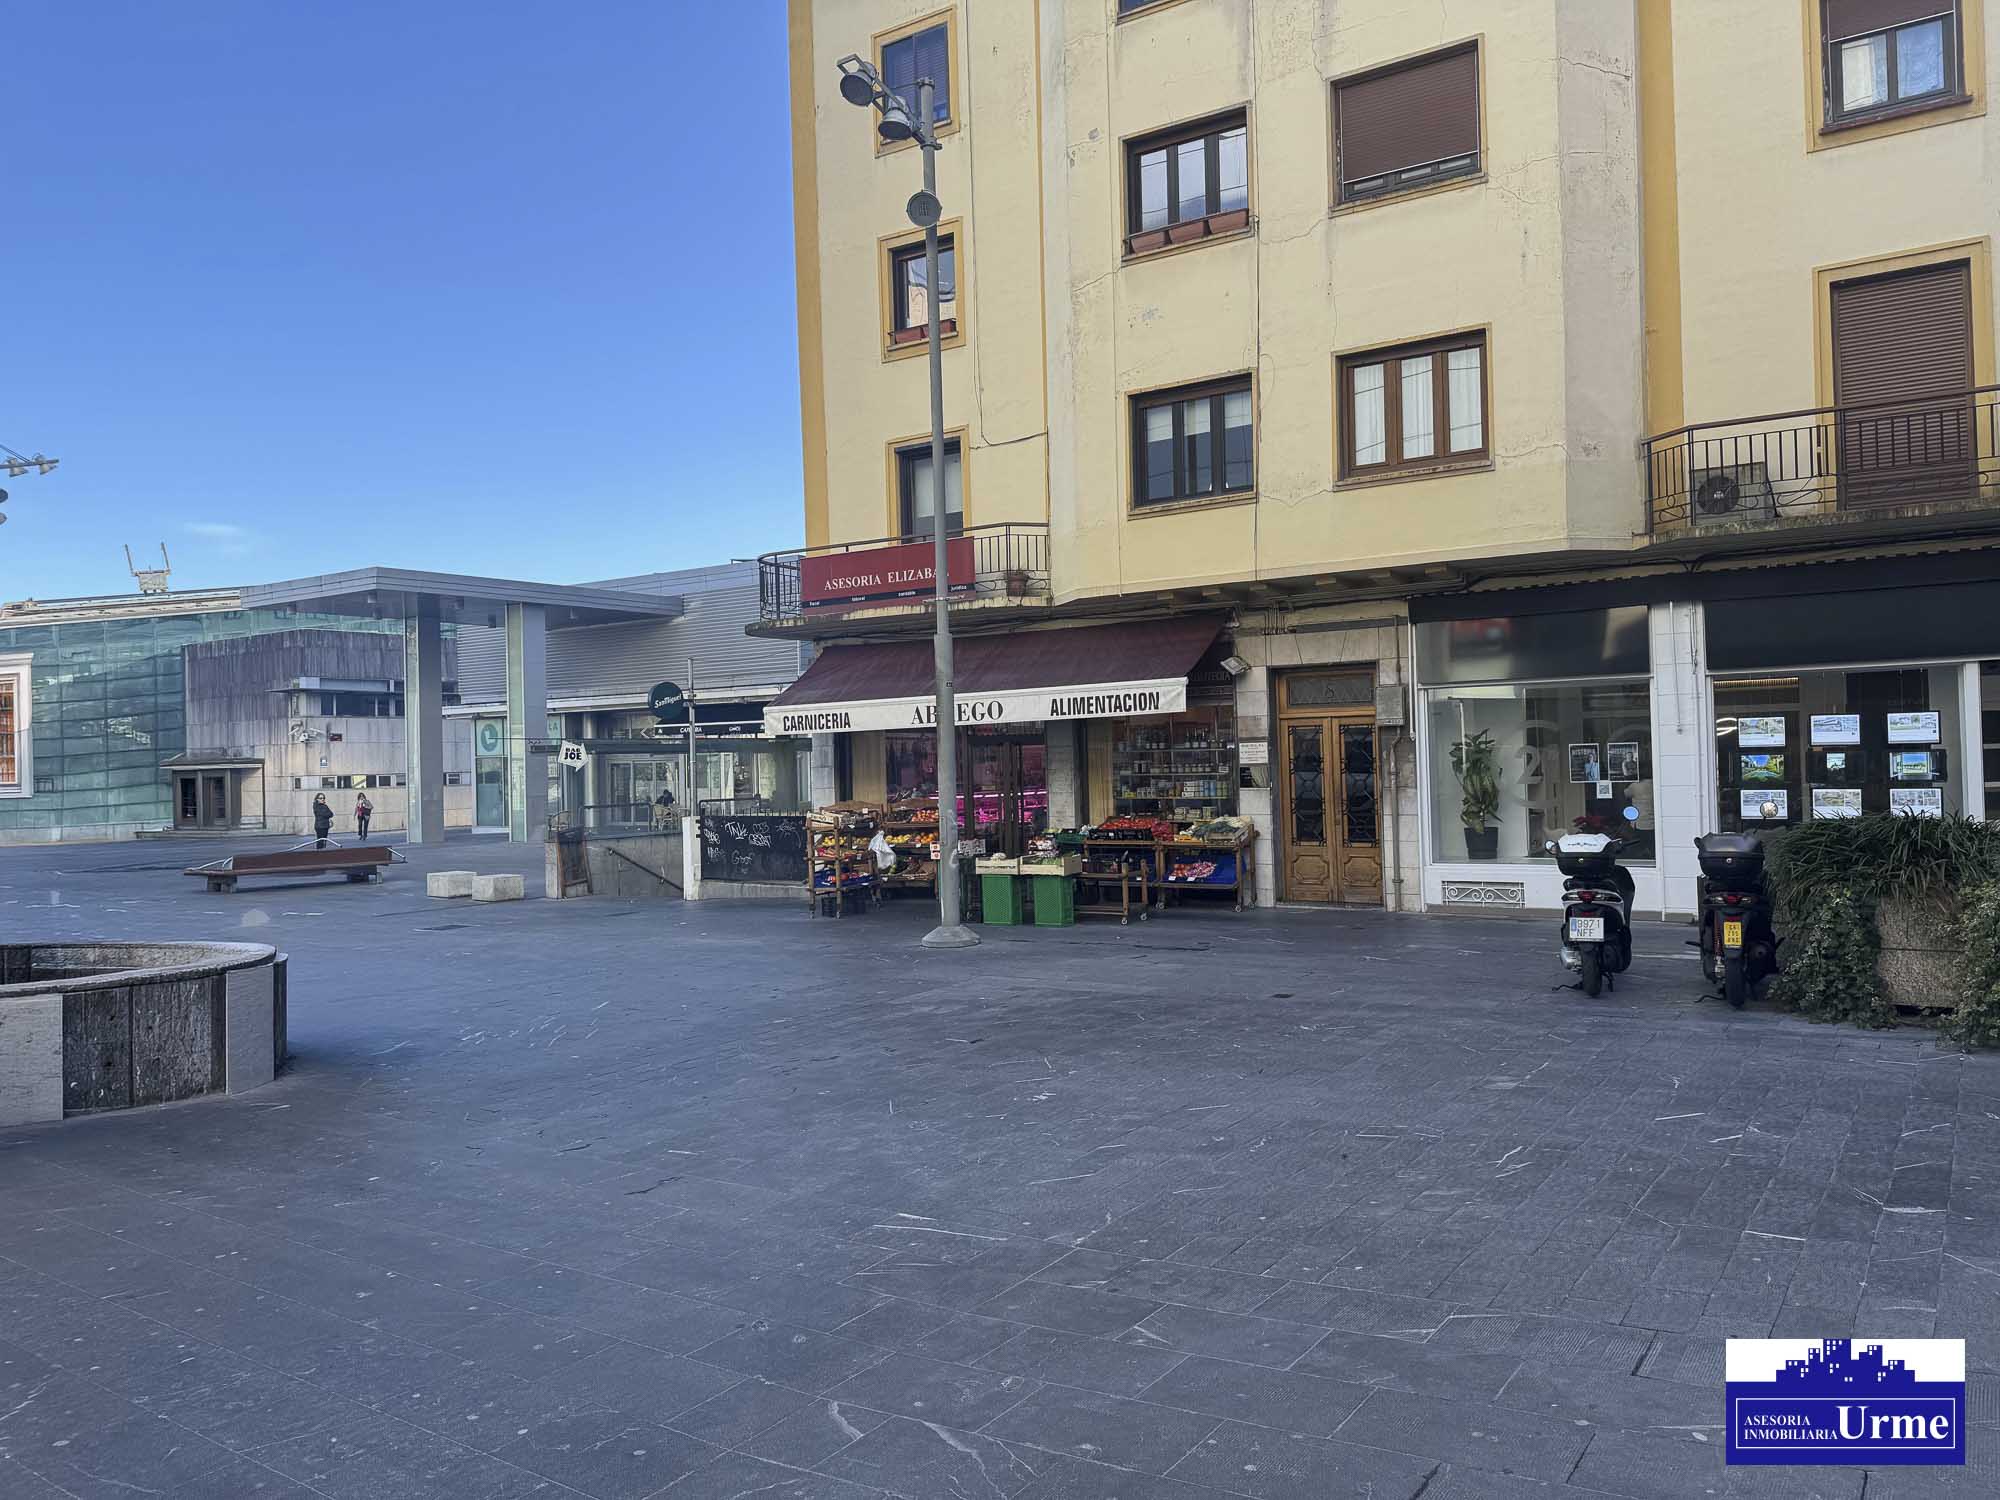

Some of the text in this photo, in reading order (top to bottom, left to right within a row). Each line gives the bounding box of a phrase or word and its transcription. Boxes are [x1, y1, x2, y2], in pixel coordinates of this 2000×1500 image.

[824, 567, 950, 592] ASESORIA ELIZAB
[782, 691, 1160, 732] CARNICERIA ABEGO ALIMENTACION
[564, 752, 582, 760] JOE
